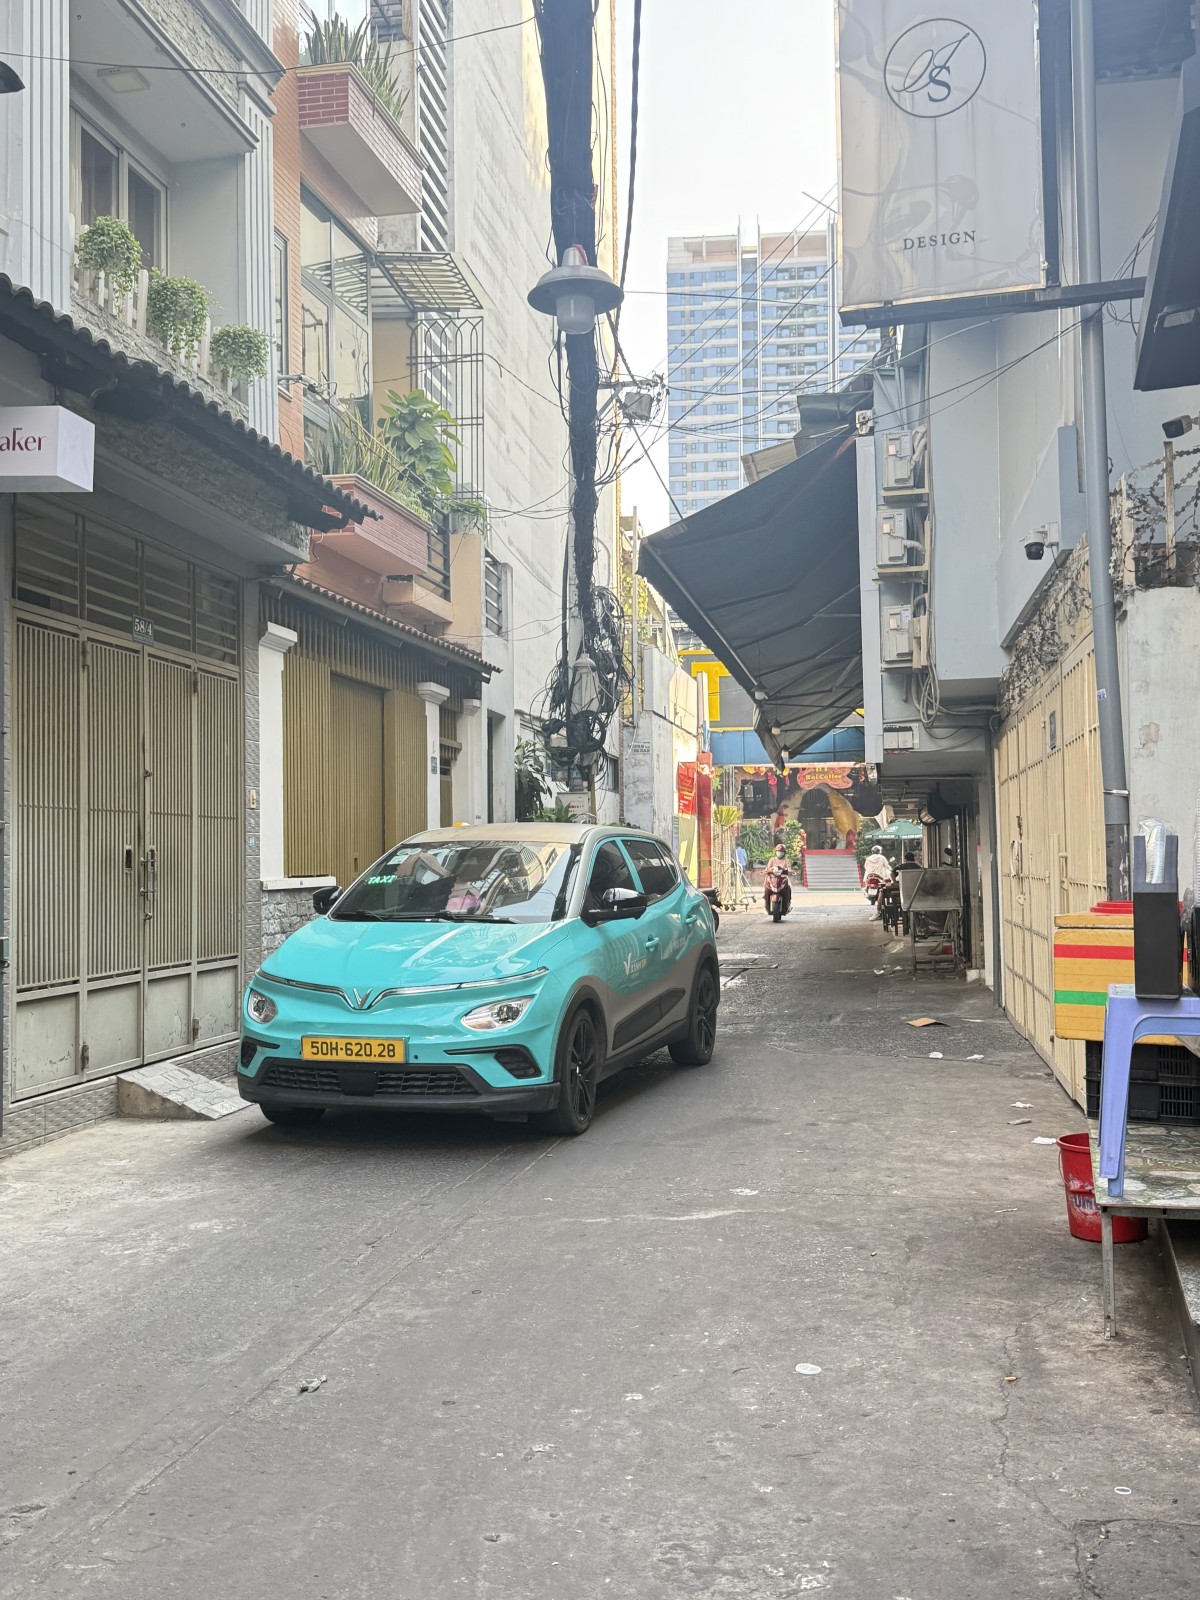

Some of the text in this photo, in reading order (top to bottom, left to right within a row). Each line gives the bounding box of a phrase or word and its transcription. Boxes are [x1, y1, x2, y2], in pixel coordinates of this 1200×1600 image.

[903, 231, 976, 250] DESIGN
[0, 427, 47, 452] aker
[134, 618, 152, 635] 58/4
[368, 875, 397, 884] TAXI
[311, 1041, 396, 1058] 50H-620.28
